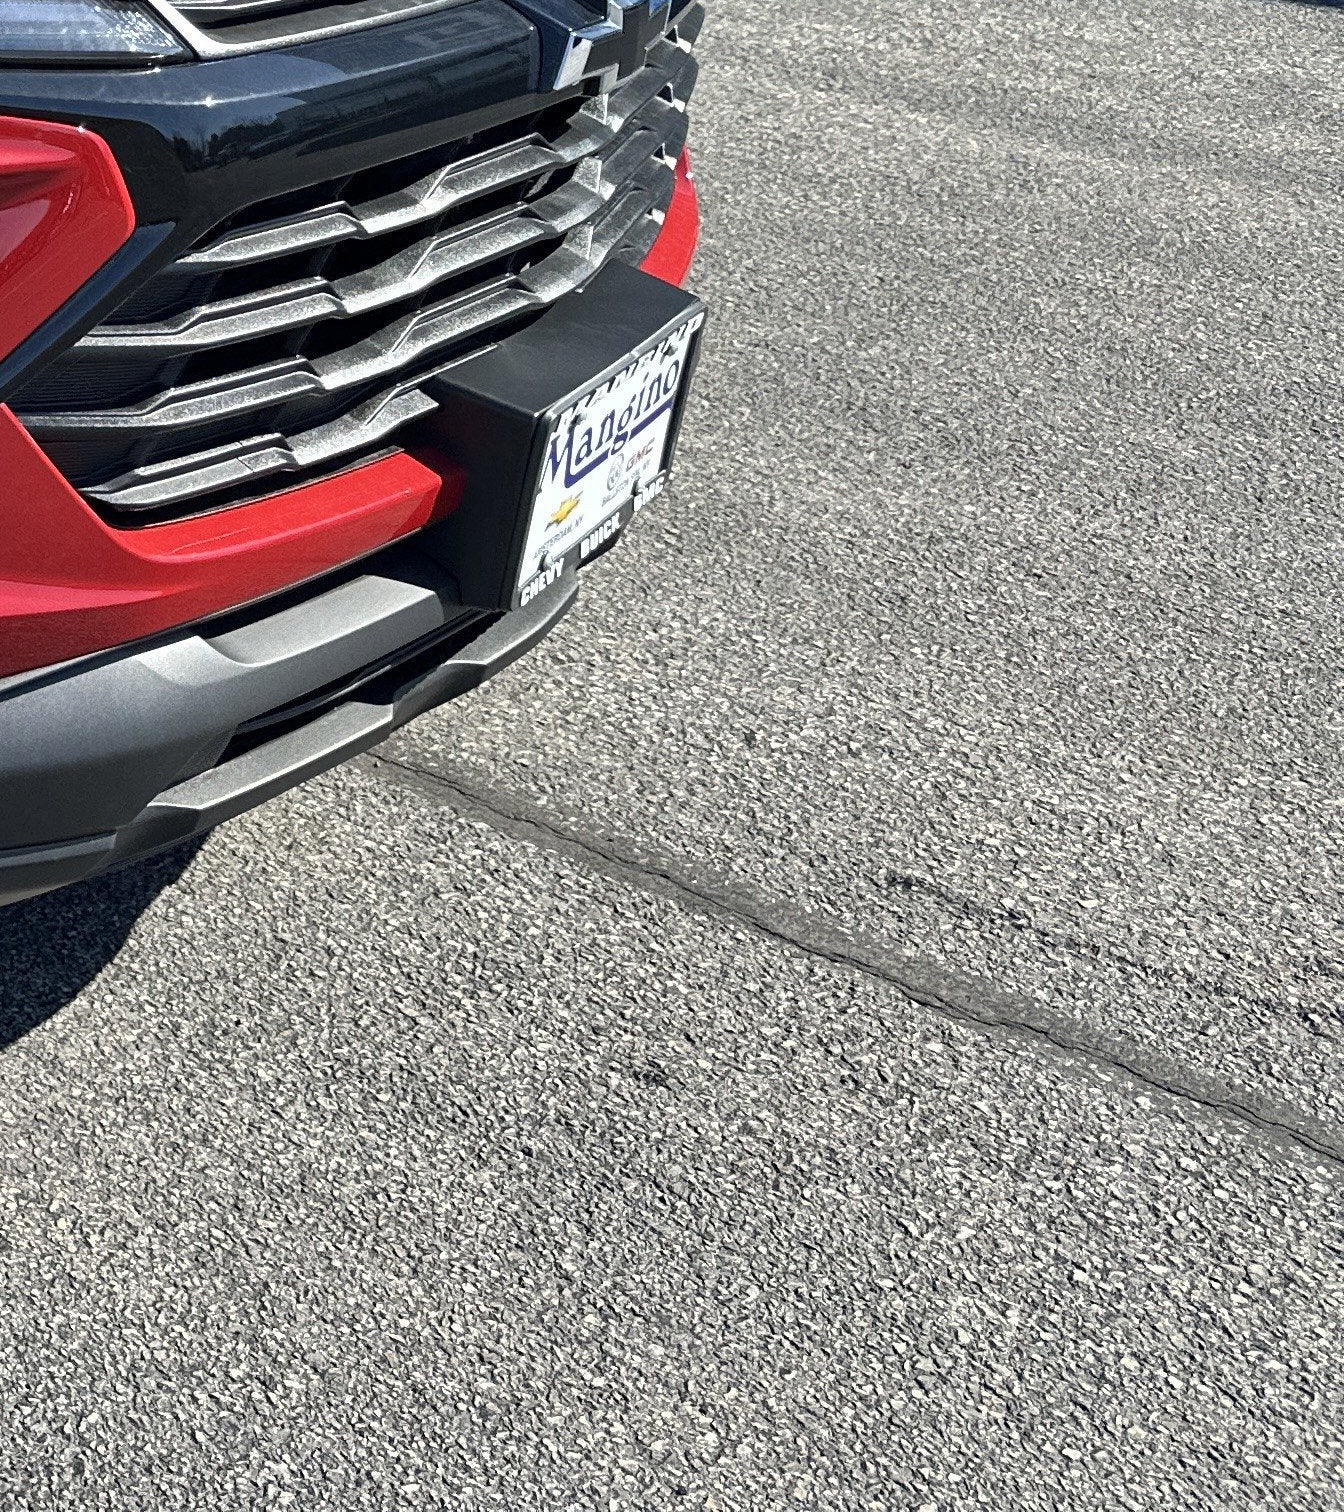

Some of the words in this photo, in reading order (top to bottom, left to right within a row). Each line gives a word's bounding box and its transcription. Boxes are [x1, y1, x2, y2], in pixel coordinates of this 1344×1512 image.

[540, 359, 679, 488] Mangino
[626, 438, 655, 472] GMC
[520, 557, 564, 607] CHEVY
[580, 512, 620, 558] BUICK
[634, 476, 665, 512] GMC
